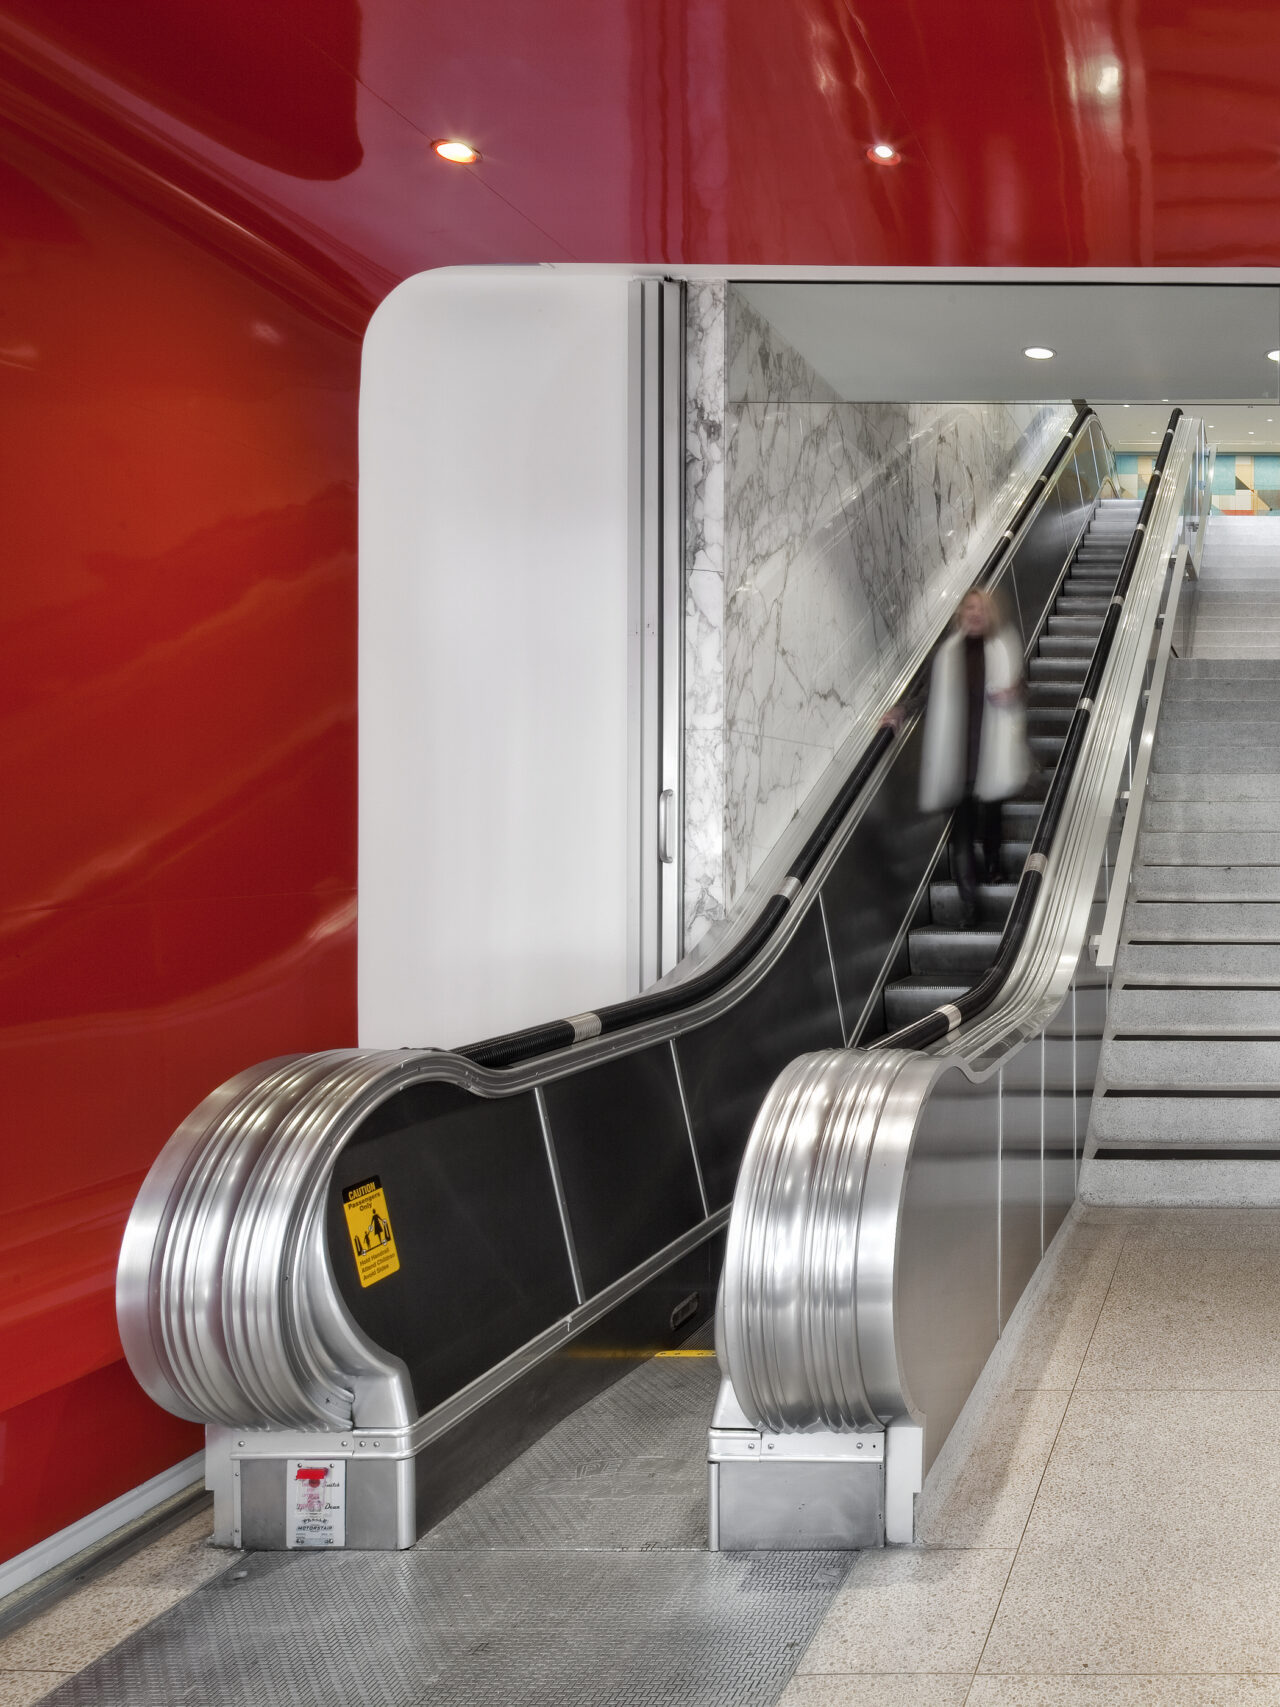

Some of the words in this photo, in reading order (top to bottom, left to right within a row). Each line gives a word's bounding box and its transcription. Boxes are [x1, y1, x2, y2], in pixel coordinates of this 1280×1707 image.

[348, 1181, 376, 1201] CAUTION
[348, 1192, 381, 1210] Passengers
[360, 1202, 373, 1211] Only
